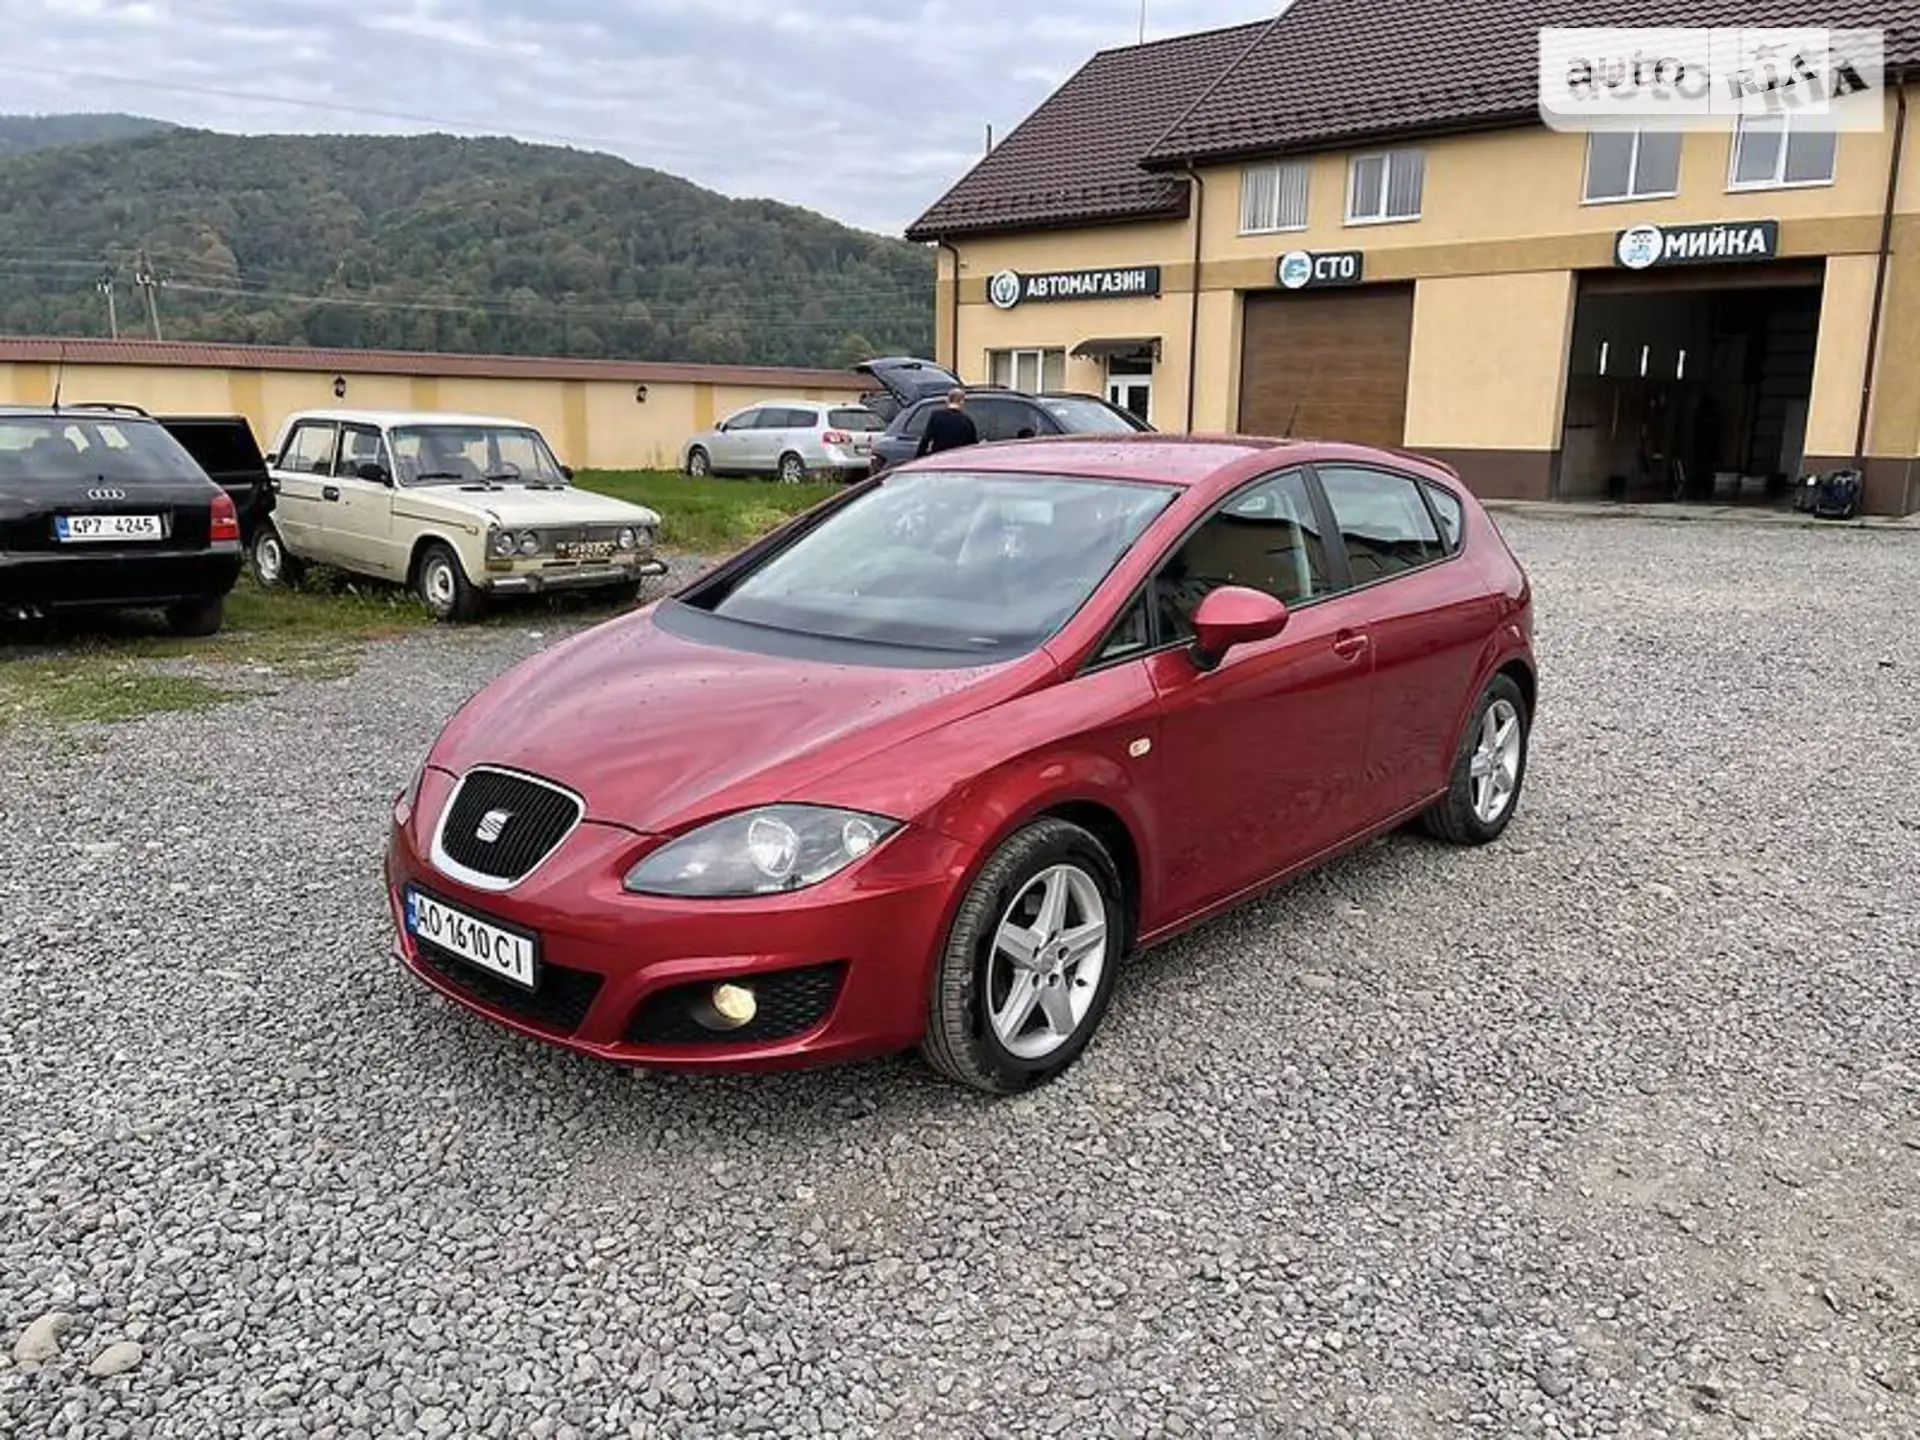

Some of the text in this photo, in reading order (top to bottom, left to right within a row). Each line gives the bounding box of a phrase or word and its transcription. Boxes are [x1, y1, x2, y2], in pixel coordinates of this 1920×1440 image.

[1664, 226, 1767, 258] МИЙКА
[1315, 255, 1355, 279] СТО
[1026, 270, 1146, 297] АВТОМАГАЗИН
[73, 518, 102, 534] 4P7
[115, 518, 155, 533] 4245
[417, 899, 442, 937] AO
[446, 913, 491, 960] 1610
[495, 935, 522, 975] CI
